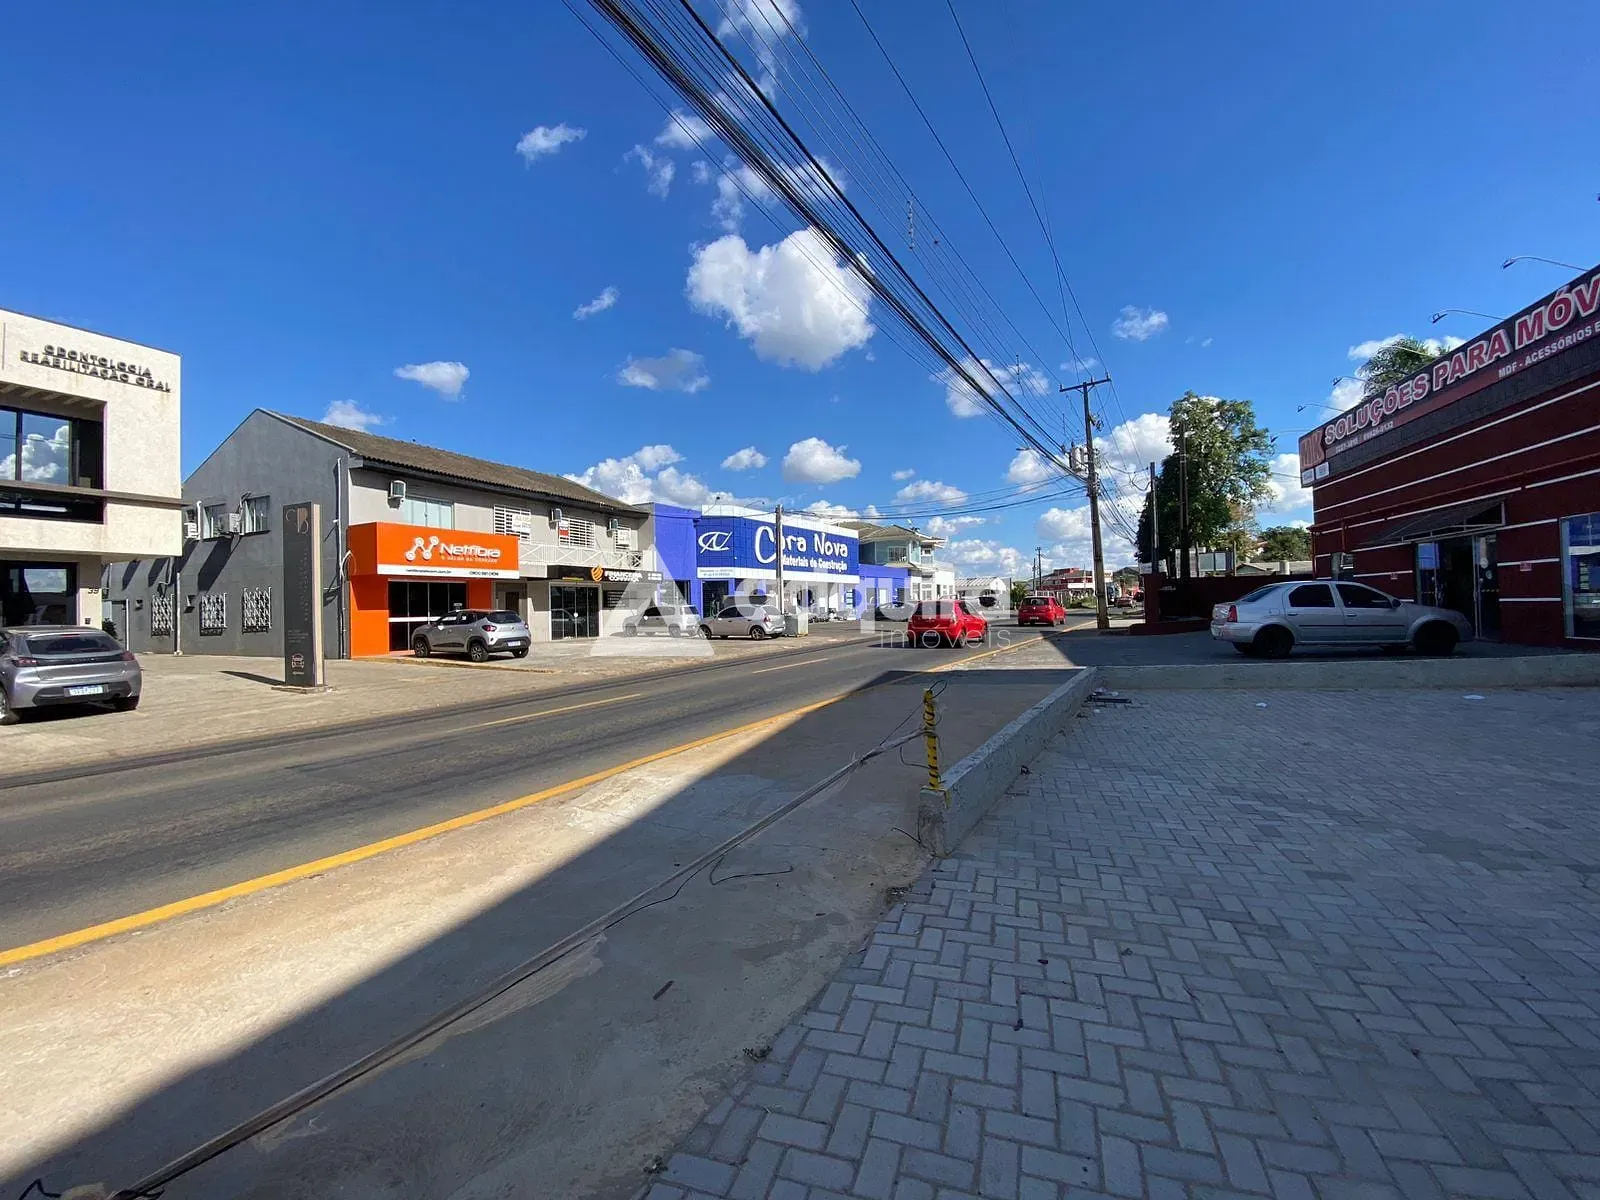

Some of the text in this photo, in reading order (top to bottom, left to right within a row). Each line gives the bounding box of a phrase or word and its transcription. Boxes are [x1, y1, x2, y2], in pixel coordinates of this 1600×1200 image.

[43, 344, 152, 378] ODONTOLOGIA
[1498, 362, 1517, 378] MDF
[1525, 325, 1592, 365] ACESSÓRIOS
[20, 350, 171, 393] REABILITAÇÃO ORAL
[1324, 372, 1430, 445] SOLUÇÕES
[1433, 329, 1512, 391] PARA
[440, 542, 501, 558] Netfibra
[814, 532, 848, 557] Nova
[818, 558, 848, 573] Construção
